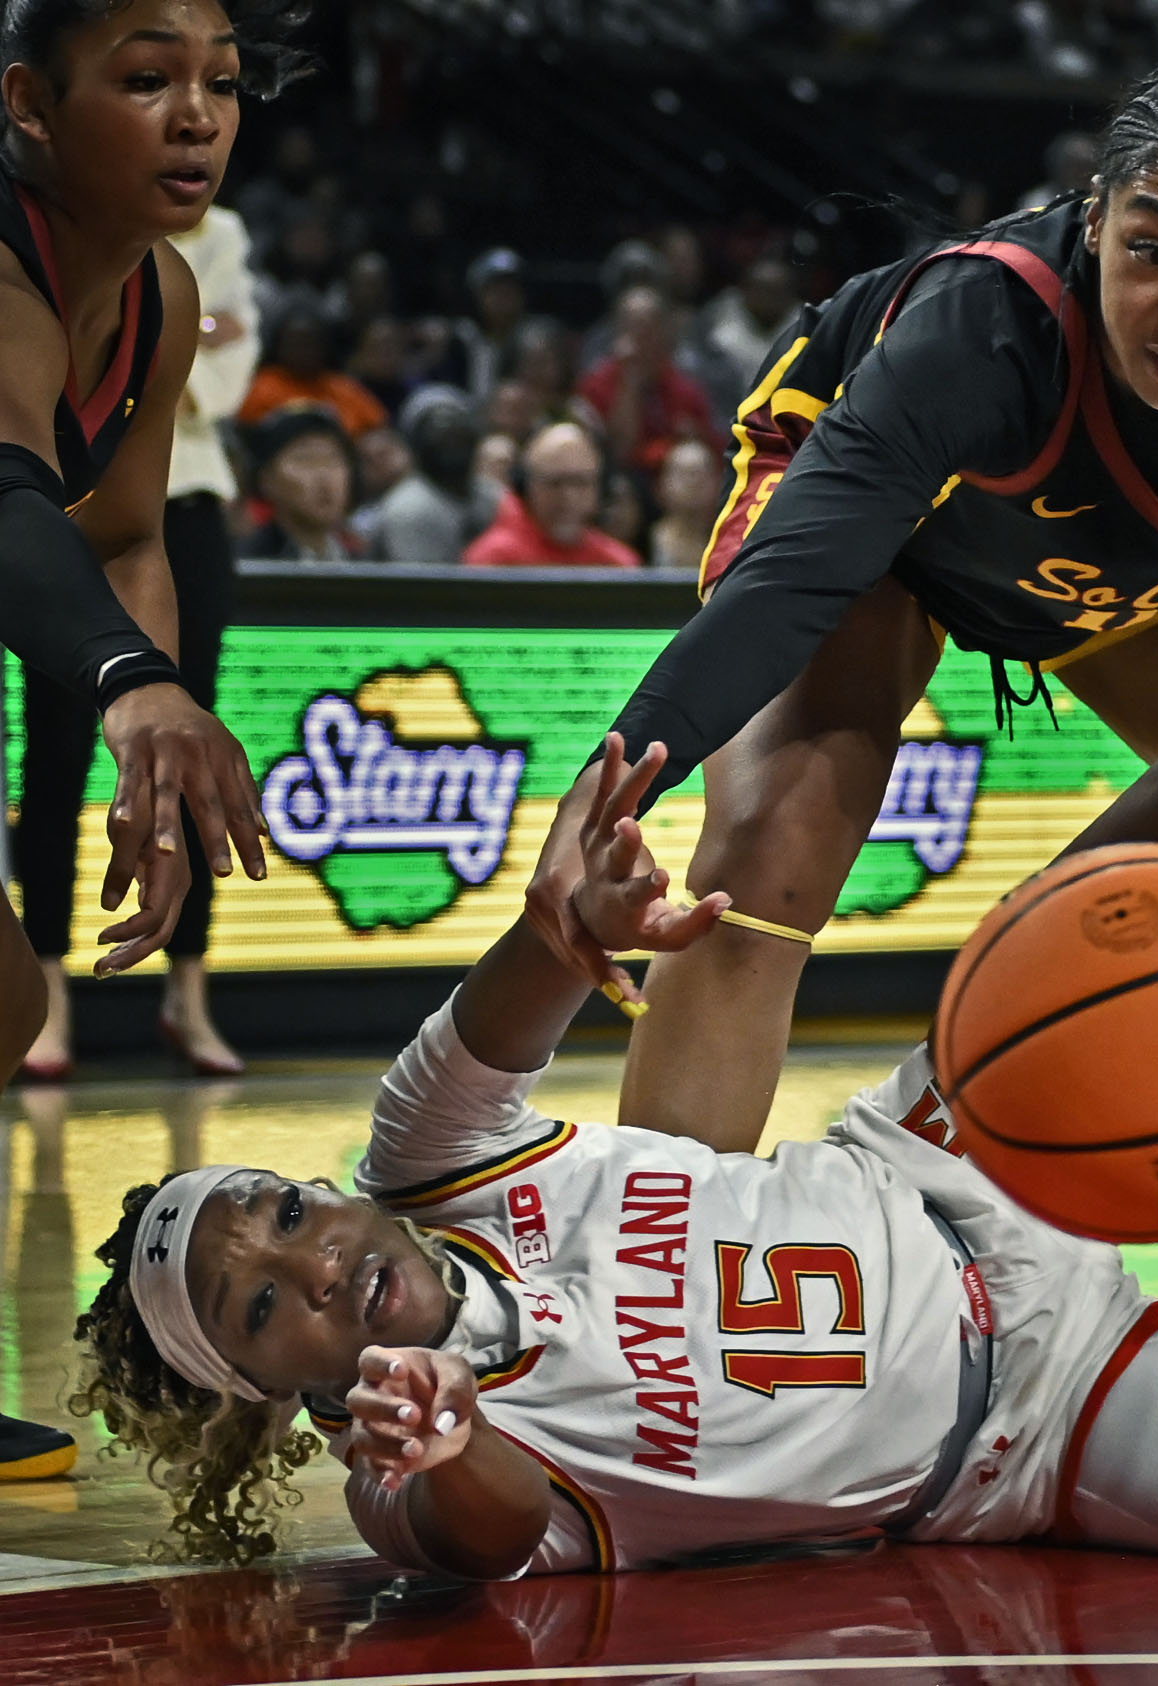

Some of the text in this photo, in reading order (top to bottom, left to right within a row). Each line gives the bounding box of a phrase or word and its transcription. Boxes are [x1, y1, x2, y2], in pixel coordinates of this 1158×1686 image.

[1016, 558, 1126, 606] So
[262, 694, 525, 883] Starry
[614, 1171, 699, 1481] MARYLAND
[714, 1239, 866, 1400] 15
[966, 1271, 988, 1330] MARYLAND
